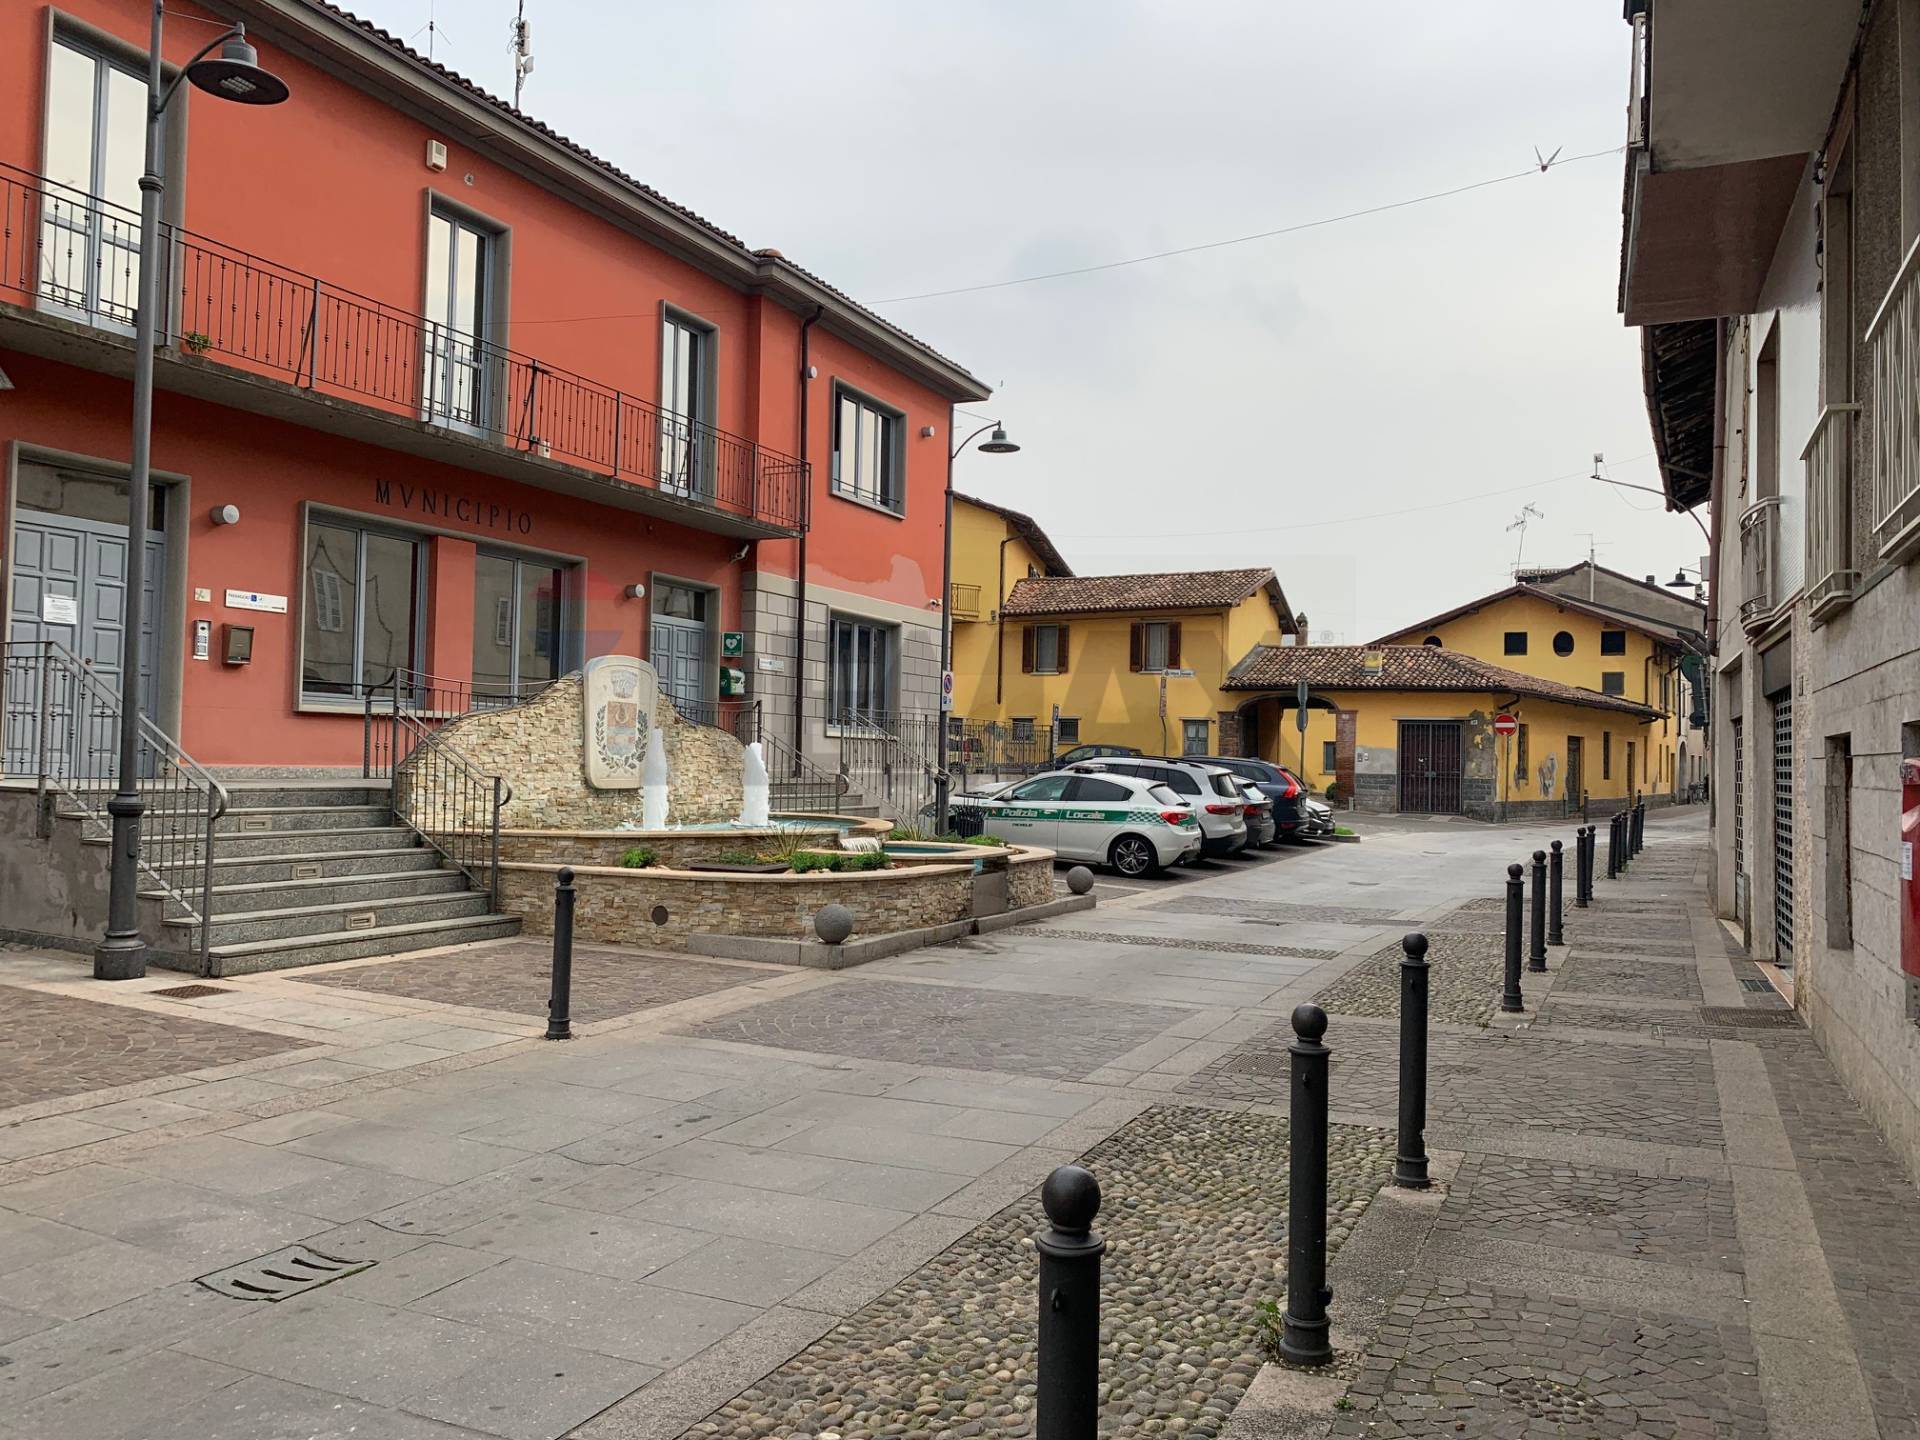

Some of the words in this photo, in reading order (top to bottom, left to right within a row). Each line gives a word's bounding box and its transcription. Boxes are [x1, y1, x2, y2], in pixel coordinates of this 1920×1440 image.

[375, 478, 532, 535] MVNICIPIO
[1002, 808, 1038, 818] Polizia
[1065, 810, 1105, 820] Locale
